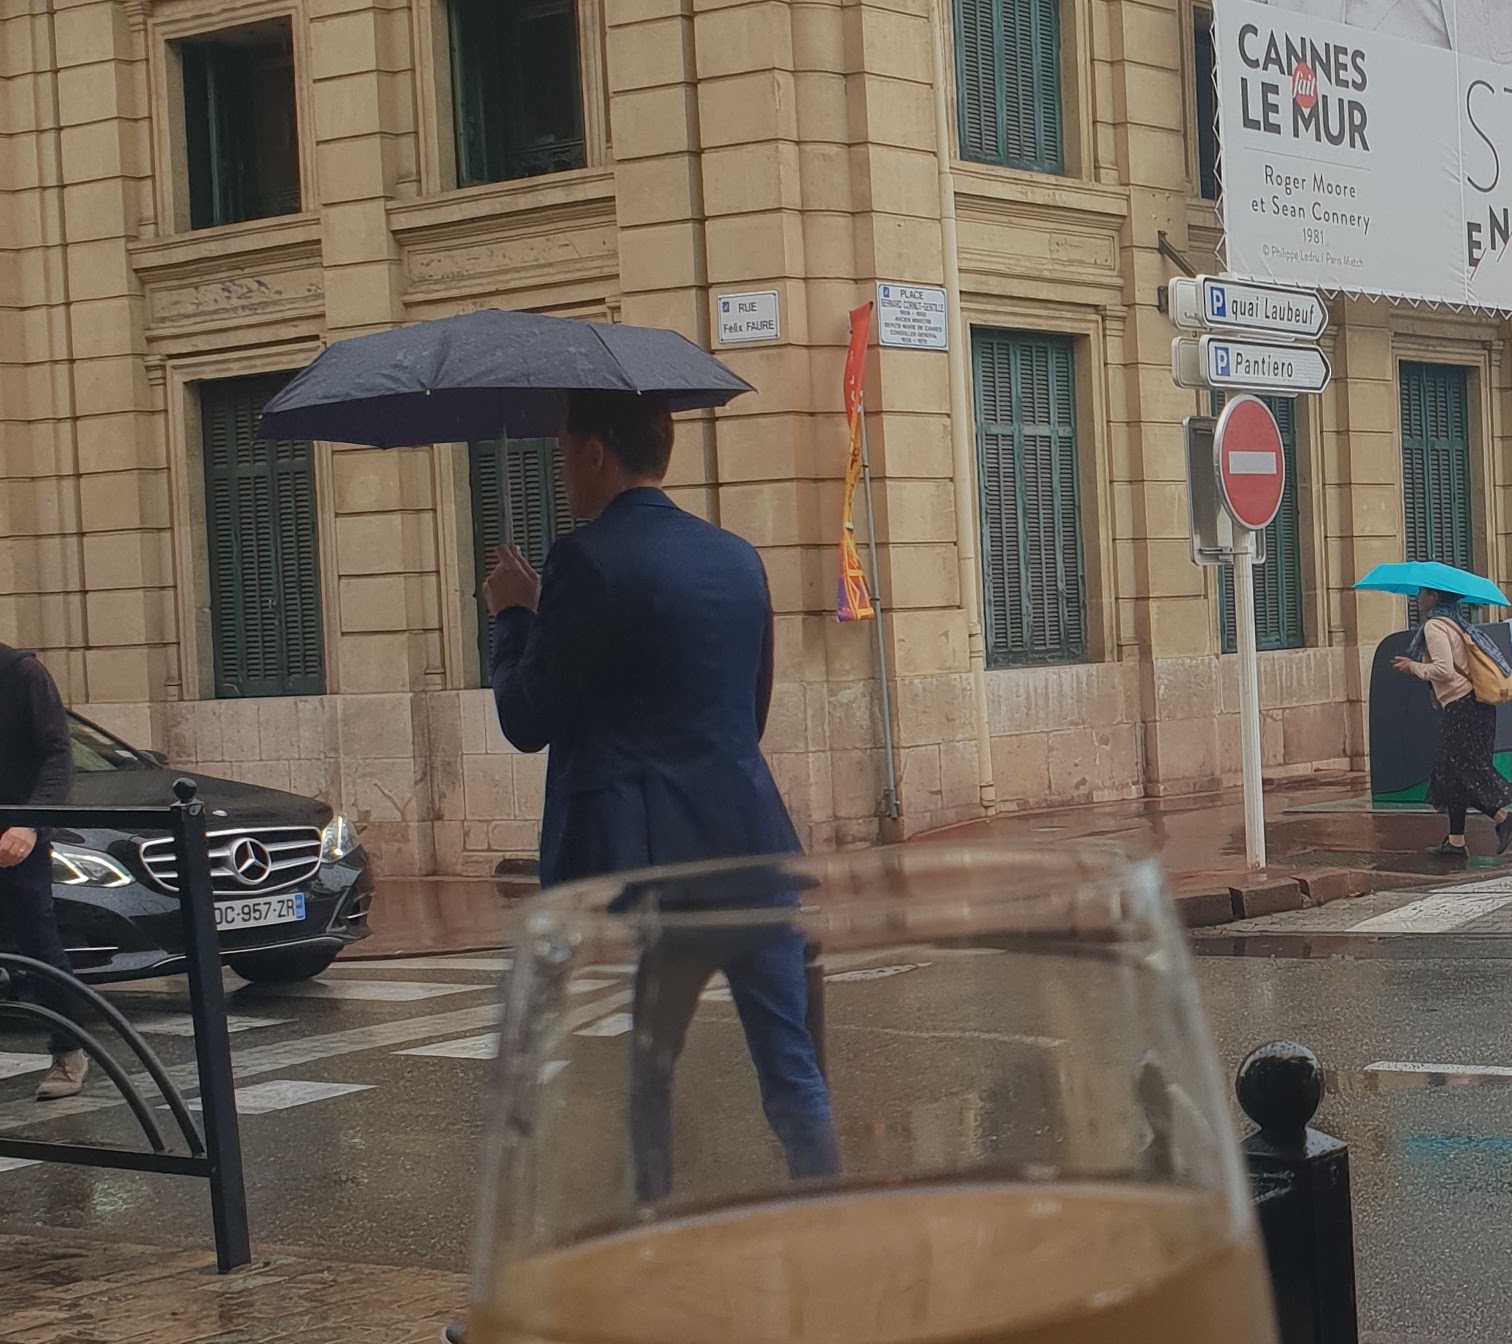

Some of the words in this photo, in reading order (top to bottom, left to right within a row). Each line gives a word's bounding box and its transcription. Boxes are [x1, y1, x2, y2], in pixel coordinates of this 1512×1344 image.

[1238, 23, 1368, 93] CANNES
[1240, 77, 1282, 135] LE
[1293, 93, 1370, 152] MUR
[1264, 164, 1307, 196] Roger
[1312, 172, 1356, 198] Moore
[1251, 197, 1266, 214] et
[1271, 195, 1306, 220] Sean
[1311, 201, 1370, 236] Connery
[1302, 227, 1324, 244] 1981
[1466, 205, 1512, 270] EN
[738, 302, 757, 313] RUE
[900, 289, 924, 300] PLACE
[1231, 296, 1259, 321] quai
[1264, 297, 1314, 325] Laubeuf
[746, 320, 774, 332] FAURE
[1235, 352, 1293, 377] Pantiero
